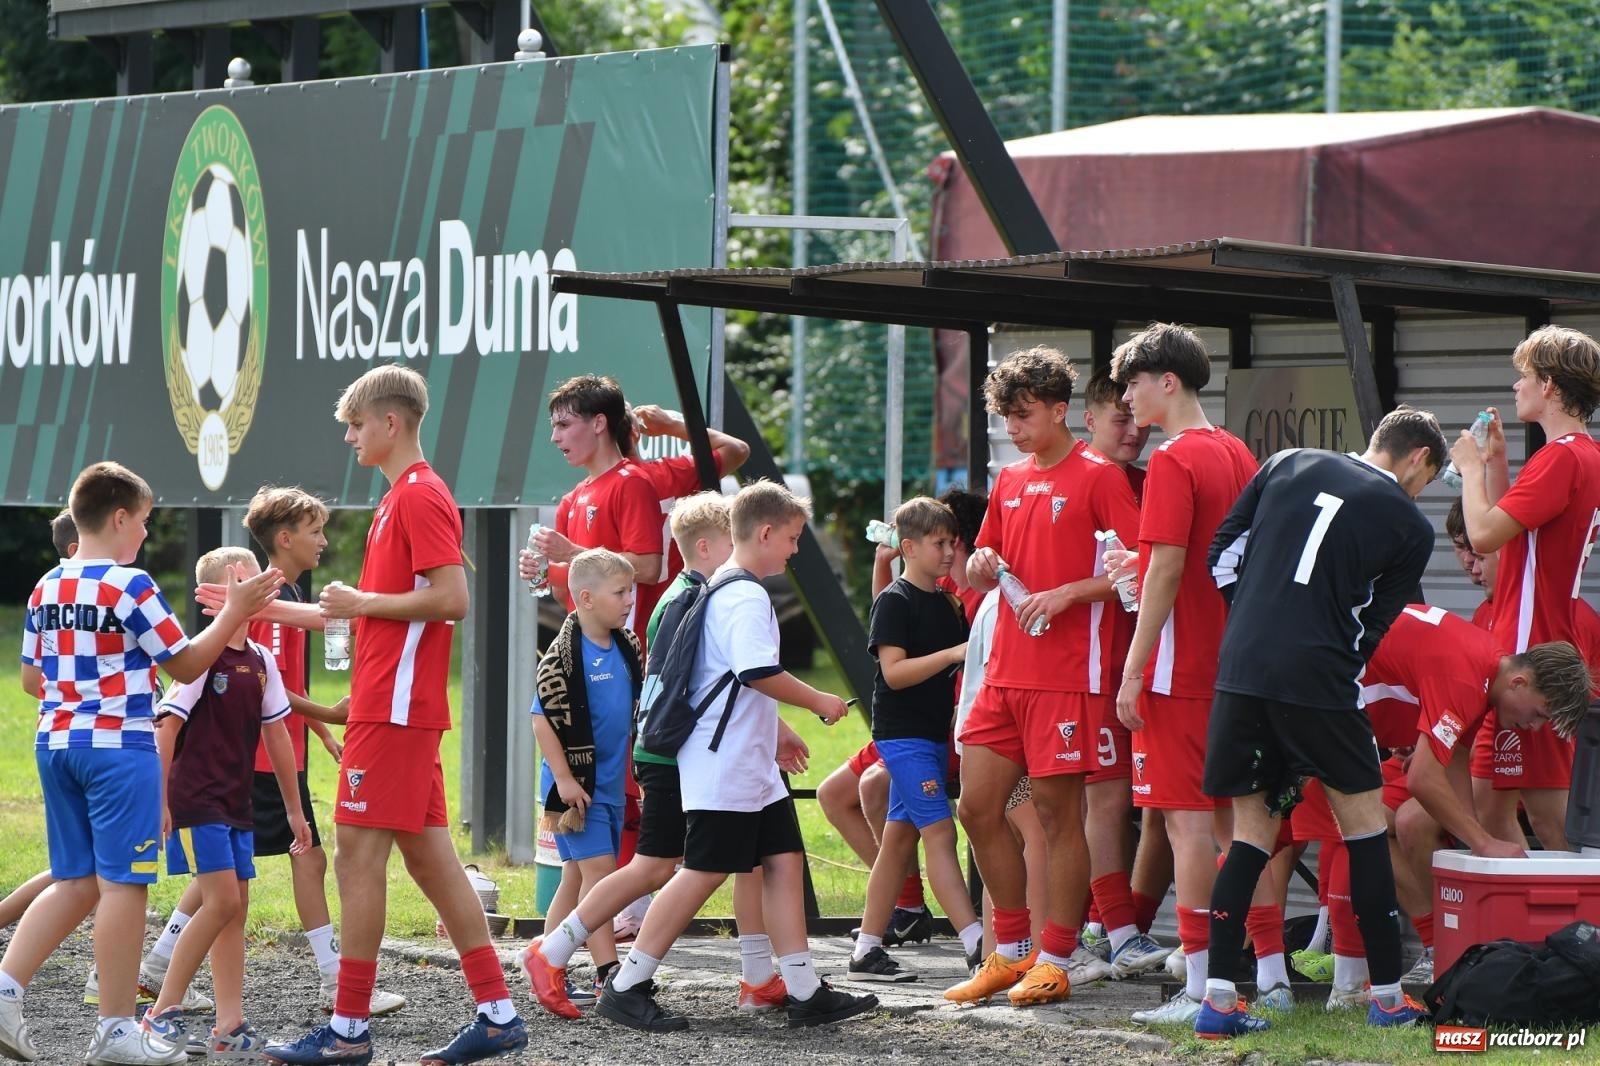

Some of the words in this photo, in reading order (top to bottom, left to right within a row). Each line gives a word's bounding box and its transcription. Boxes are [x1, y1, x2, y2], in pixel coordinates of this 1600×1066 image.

[296, 227, 429, 361] Nasza
[438, 219, 579, 356] Duma
[1245, 391, 1347, 461] GOŚCIE
[1293, 491, 1345, 586] 1
[31, 603, 127, 634] ORCIDA
[536, 636, 572, 730] ZABRZ
[1494, 753, 1522, 762] ZARYS
[1495, 765, 1523, 775] capelli
